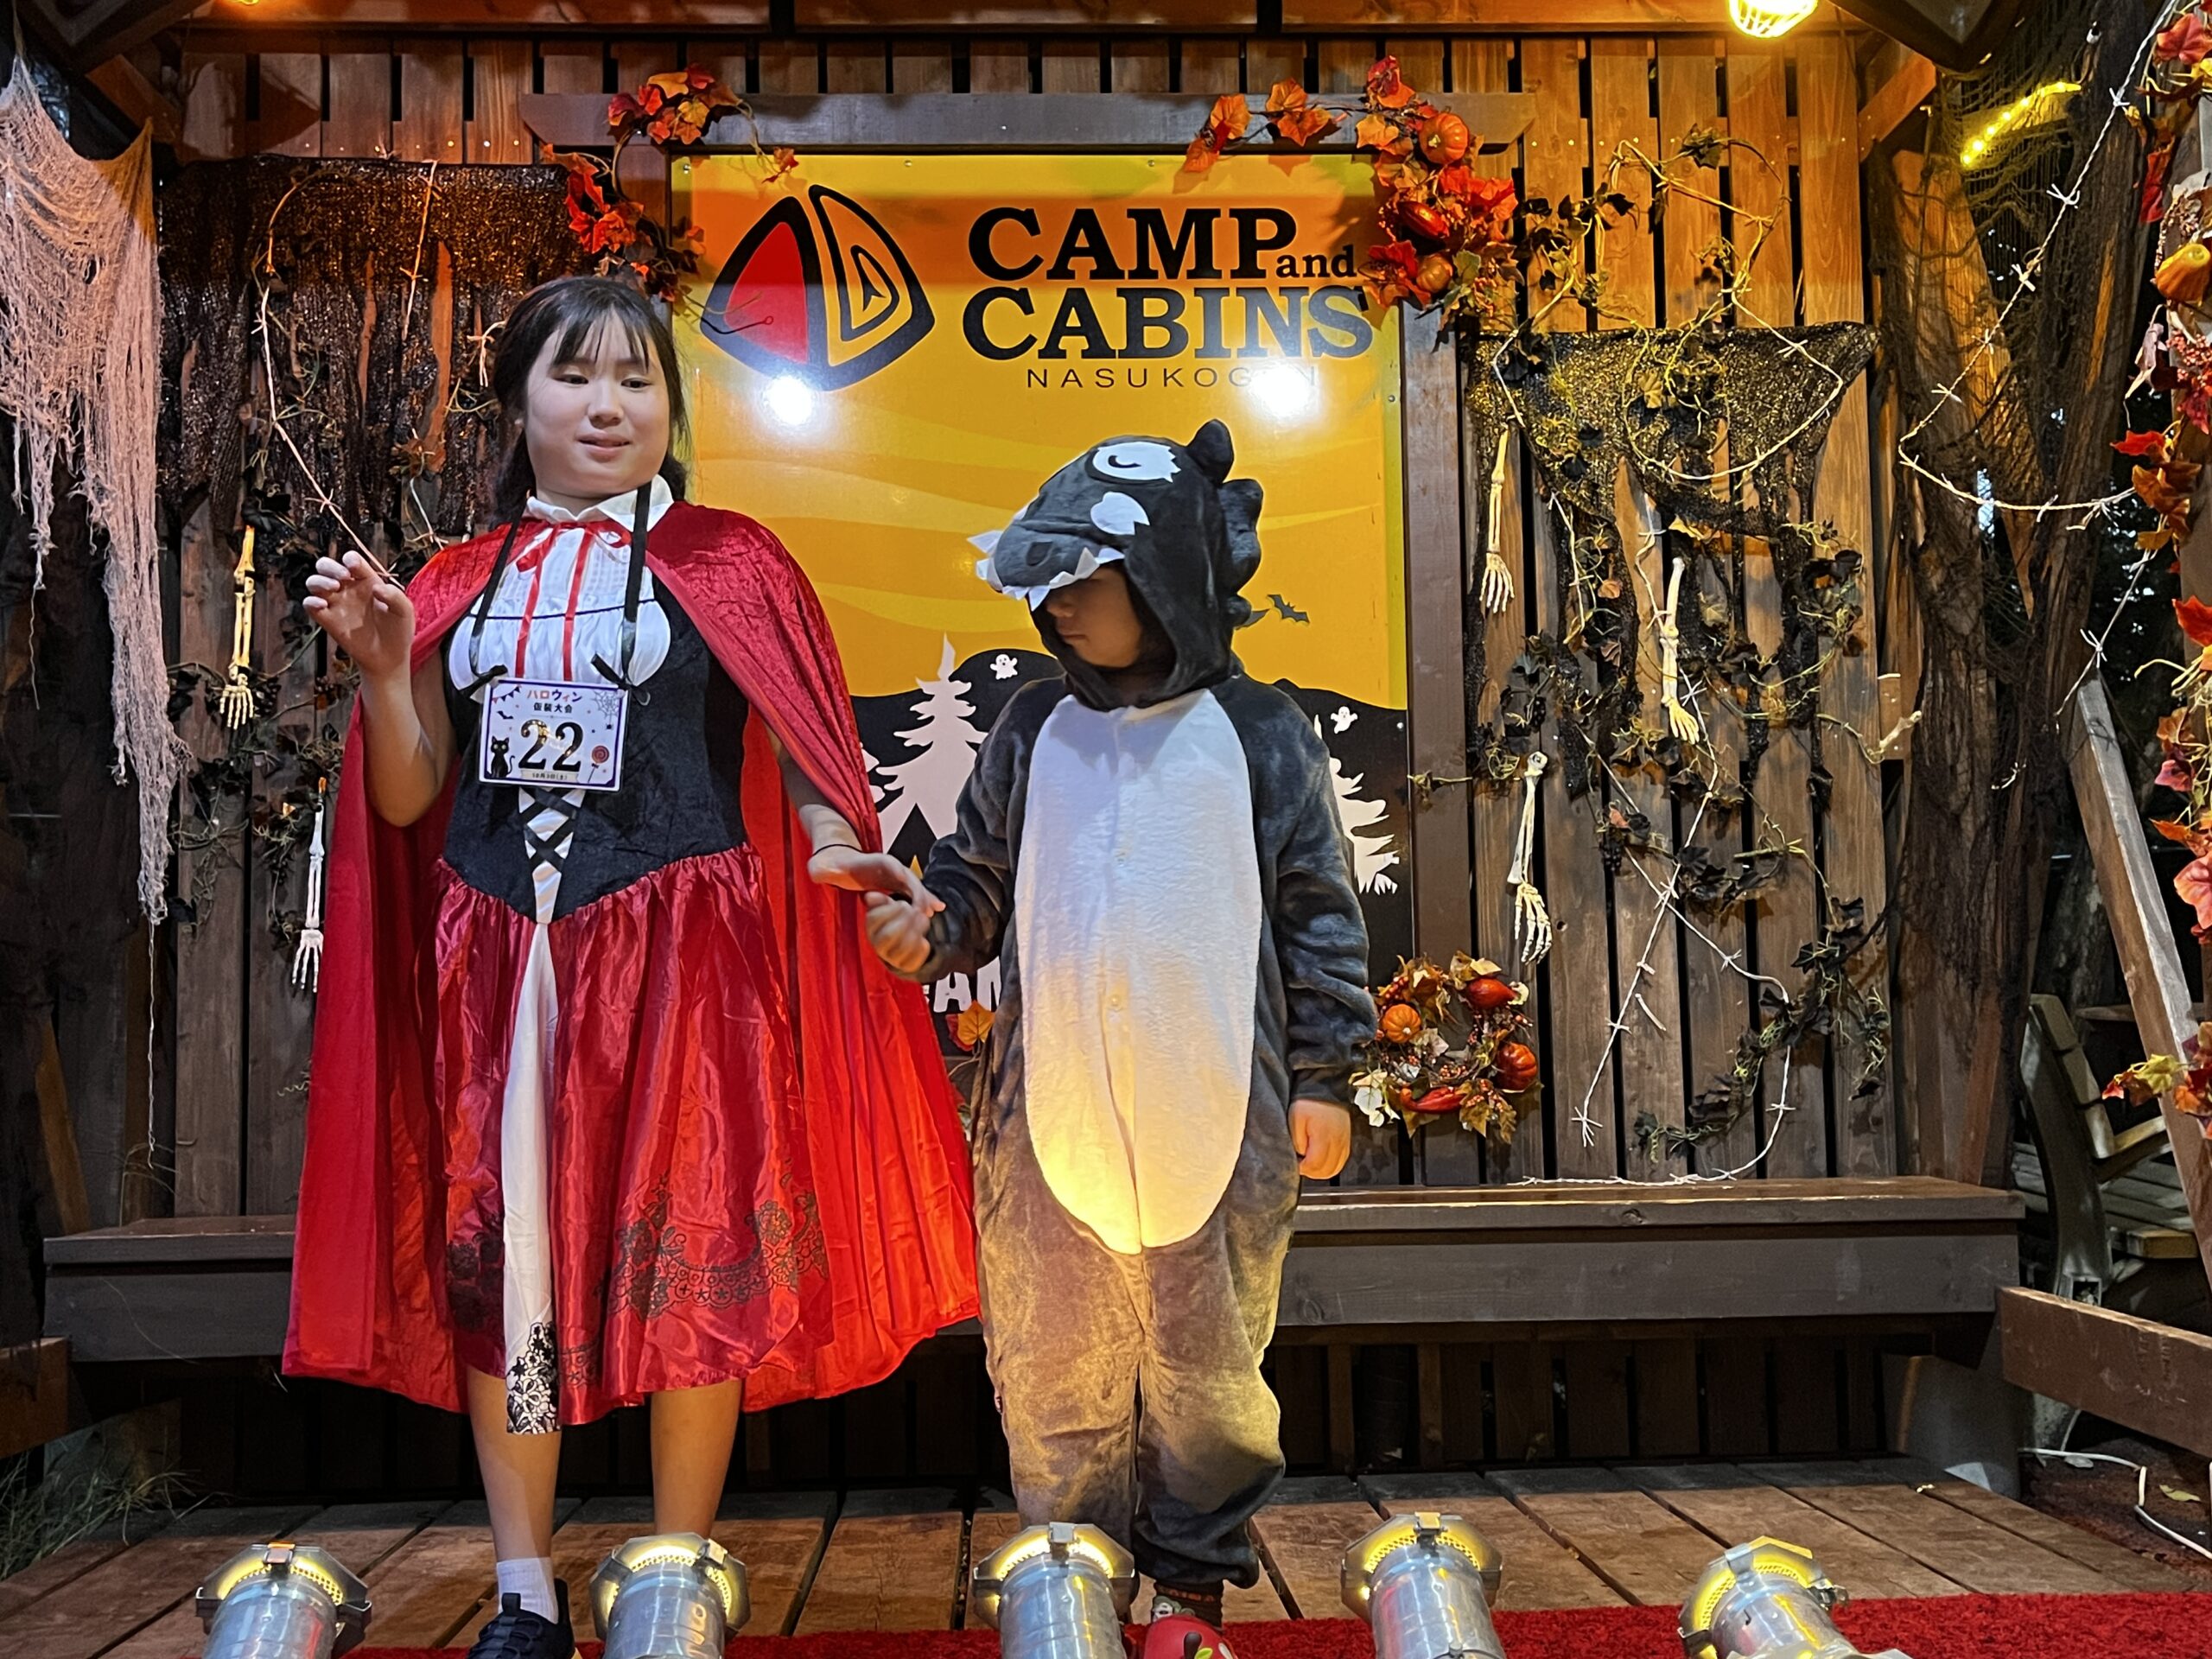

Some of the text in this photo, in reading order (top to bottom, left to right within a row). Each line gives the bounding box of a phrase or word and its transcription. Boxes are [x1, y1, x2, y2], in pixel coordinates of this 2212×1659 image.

[969, 207, 1357, 281] CAMP and
[963, 286, 1373, 360] CABINS
[1027, 368, 1316, 388] NASUKOGN
[527, 690, 582, 702] ハロウィン
[519, 719, 583, 772] 22
